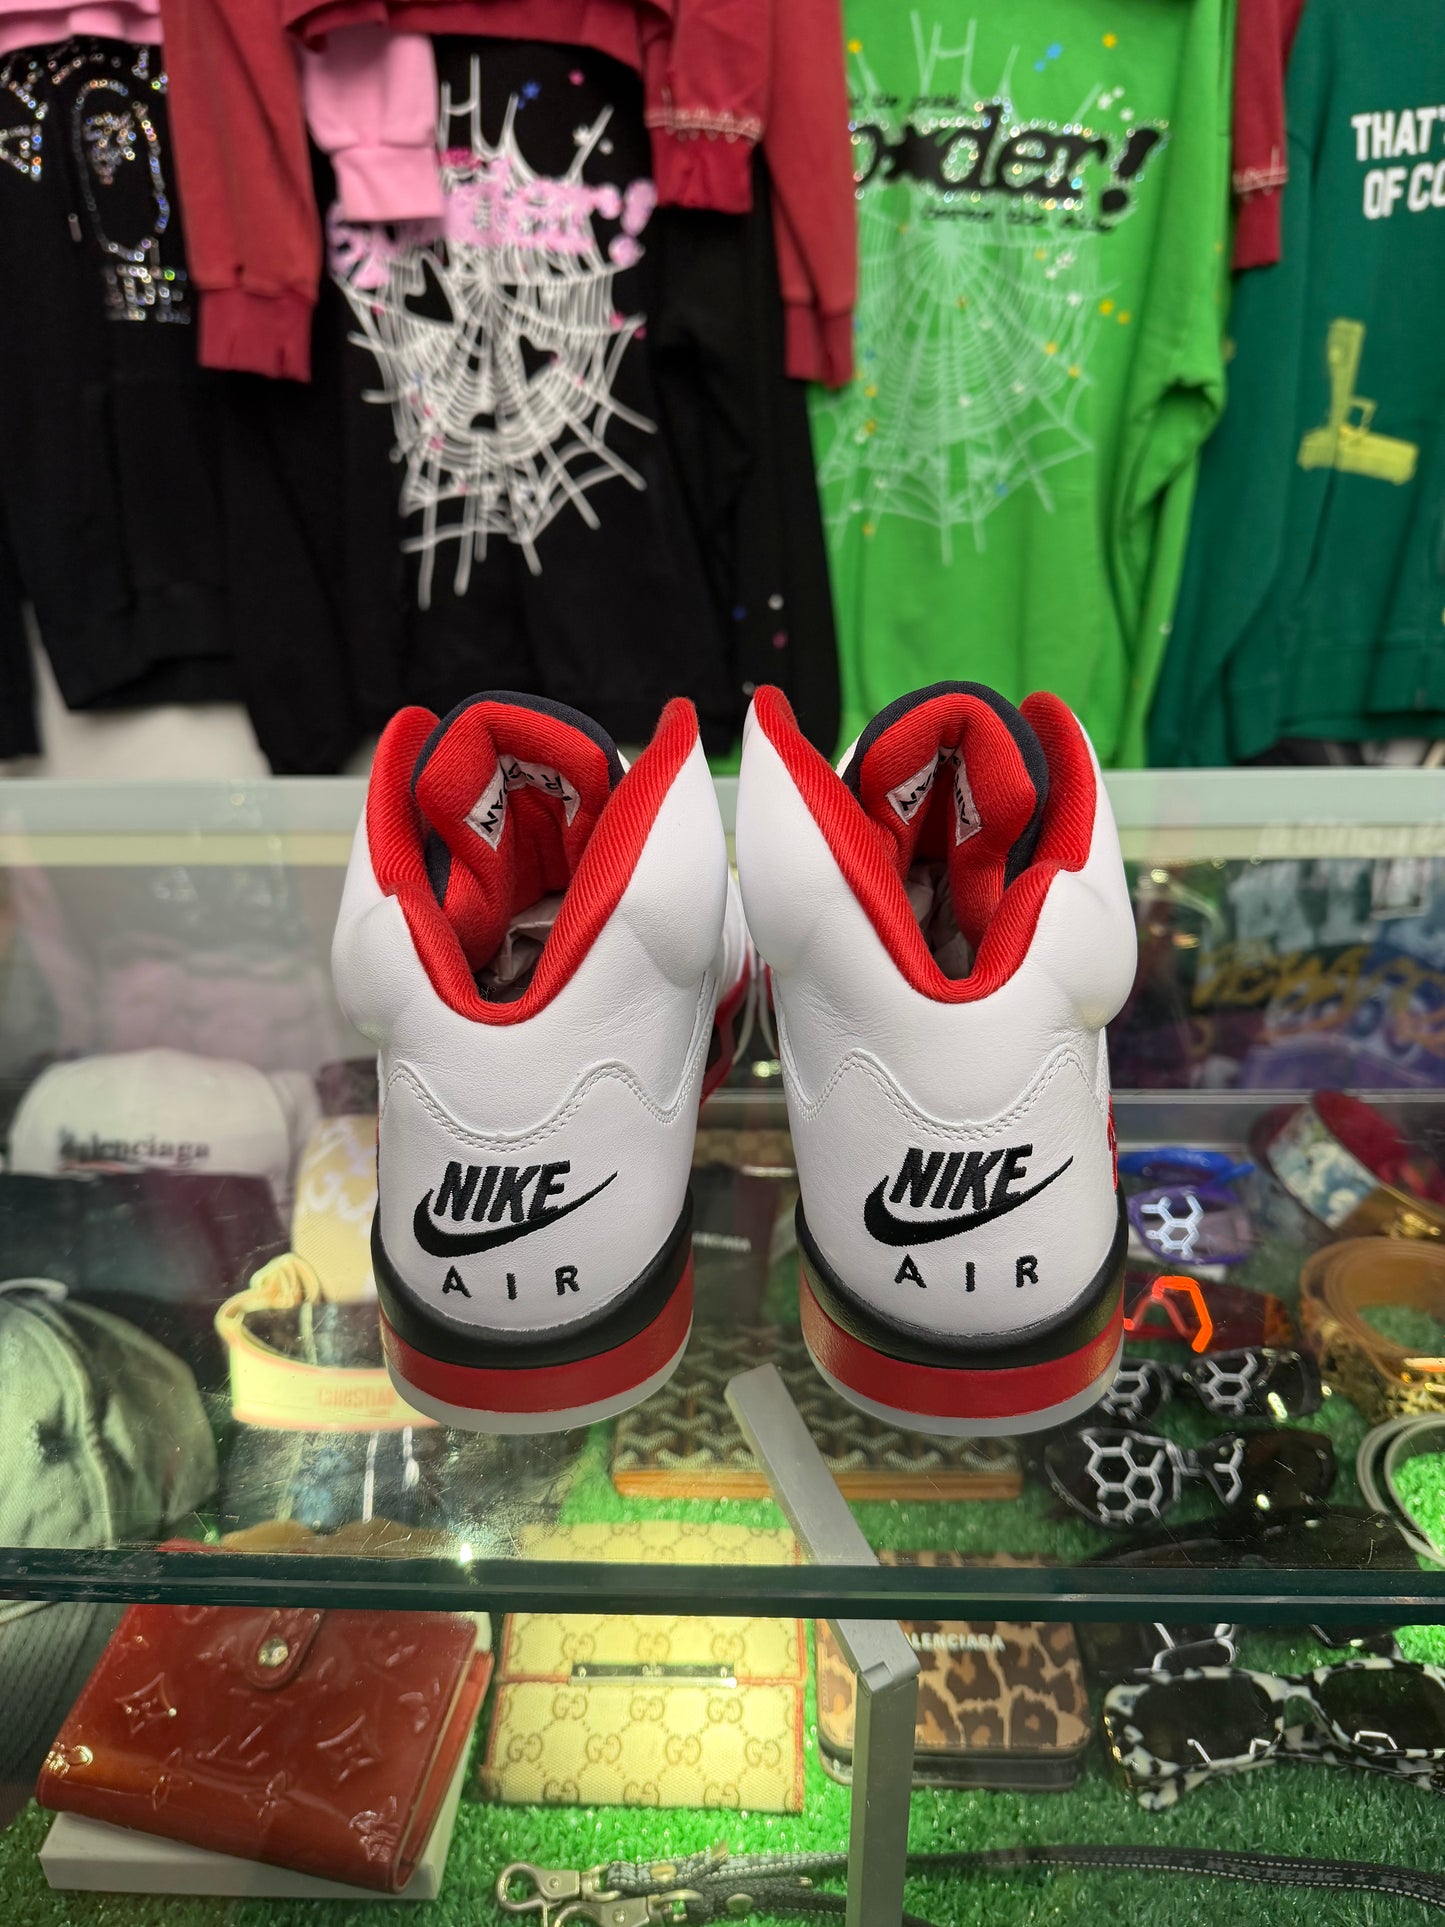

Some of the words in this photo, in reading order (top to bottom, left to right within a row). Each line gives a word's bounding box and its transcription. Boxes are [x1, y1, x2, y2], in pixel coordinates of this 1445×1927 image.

[1363, 167, 1407, 220] OF
[433, 1160, 571, 1222] NIKE
[889, 1144, 1033, 1210] NIKE
[442, 1265, 581, 1301] AIR
[894, 1254, 1039, 1293] AIR
[904, 1631, 1006, 1652] LENCIAGA
